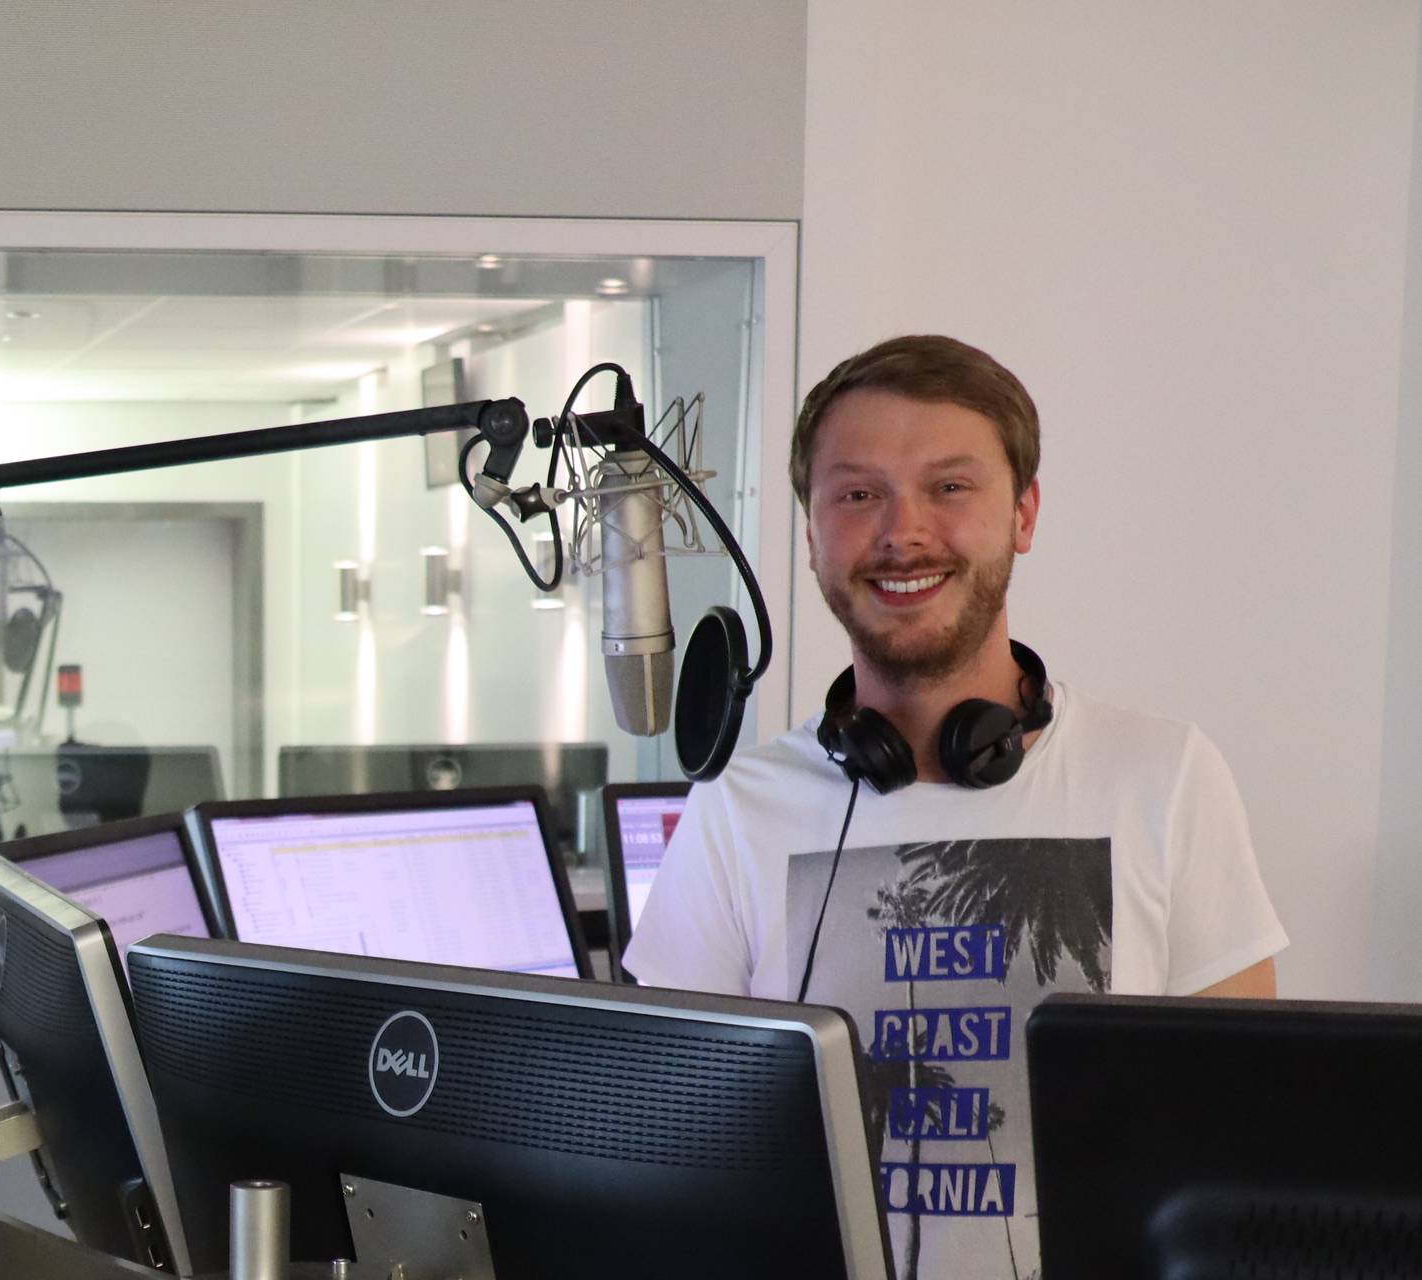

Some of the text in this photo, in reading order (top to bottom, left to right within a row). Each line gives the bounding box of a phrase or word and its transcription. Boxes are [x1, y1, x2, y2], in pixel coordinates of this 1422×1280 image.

[891, 929, 1000, 977] WEST
[881, 1012, 1006, 1057] COAST
[376, 1047, 430, 1079] DELL
[880, 1167, 1005, 1212] ORNIA
